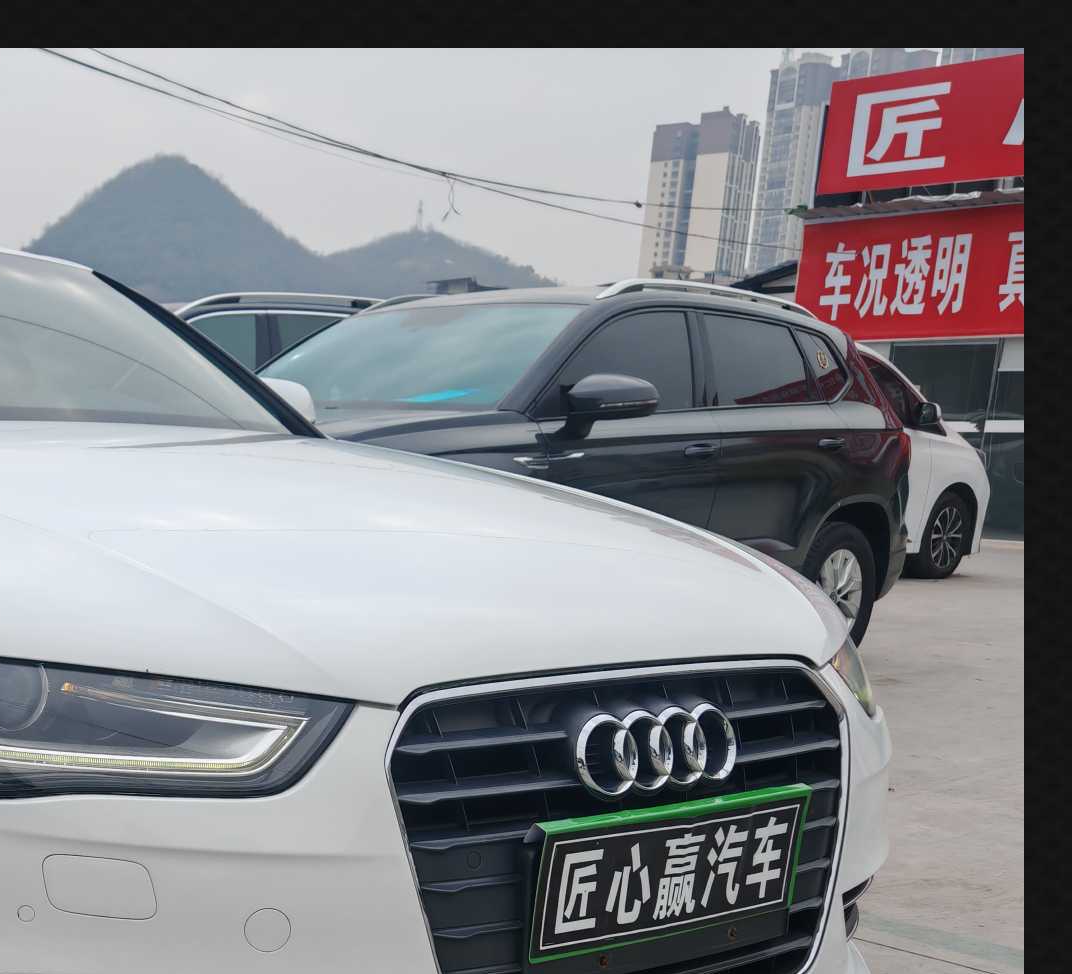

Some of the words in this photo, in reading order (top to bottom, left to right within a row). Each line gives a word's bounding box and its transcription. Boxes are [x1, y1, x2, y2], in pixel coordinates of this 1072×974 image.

[846, 81, 1024, 177] 匠
[819, 232, 973, 321] 车况透明
[554, 816, 788, 935] 匠心赢汽车
